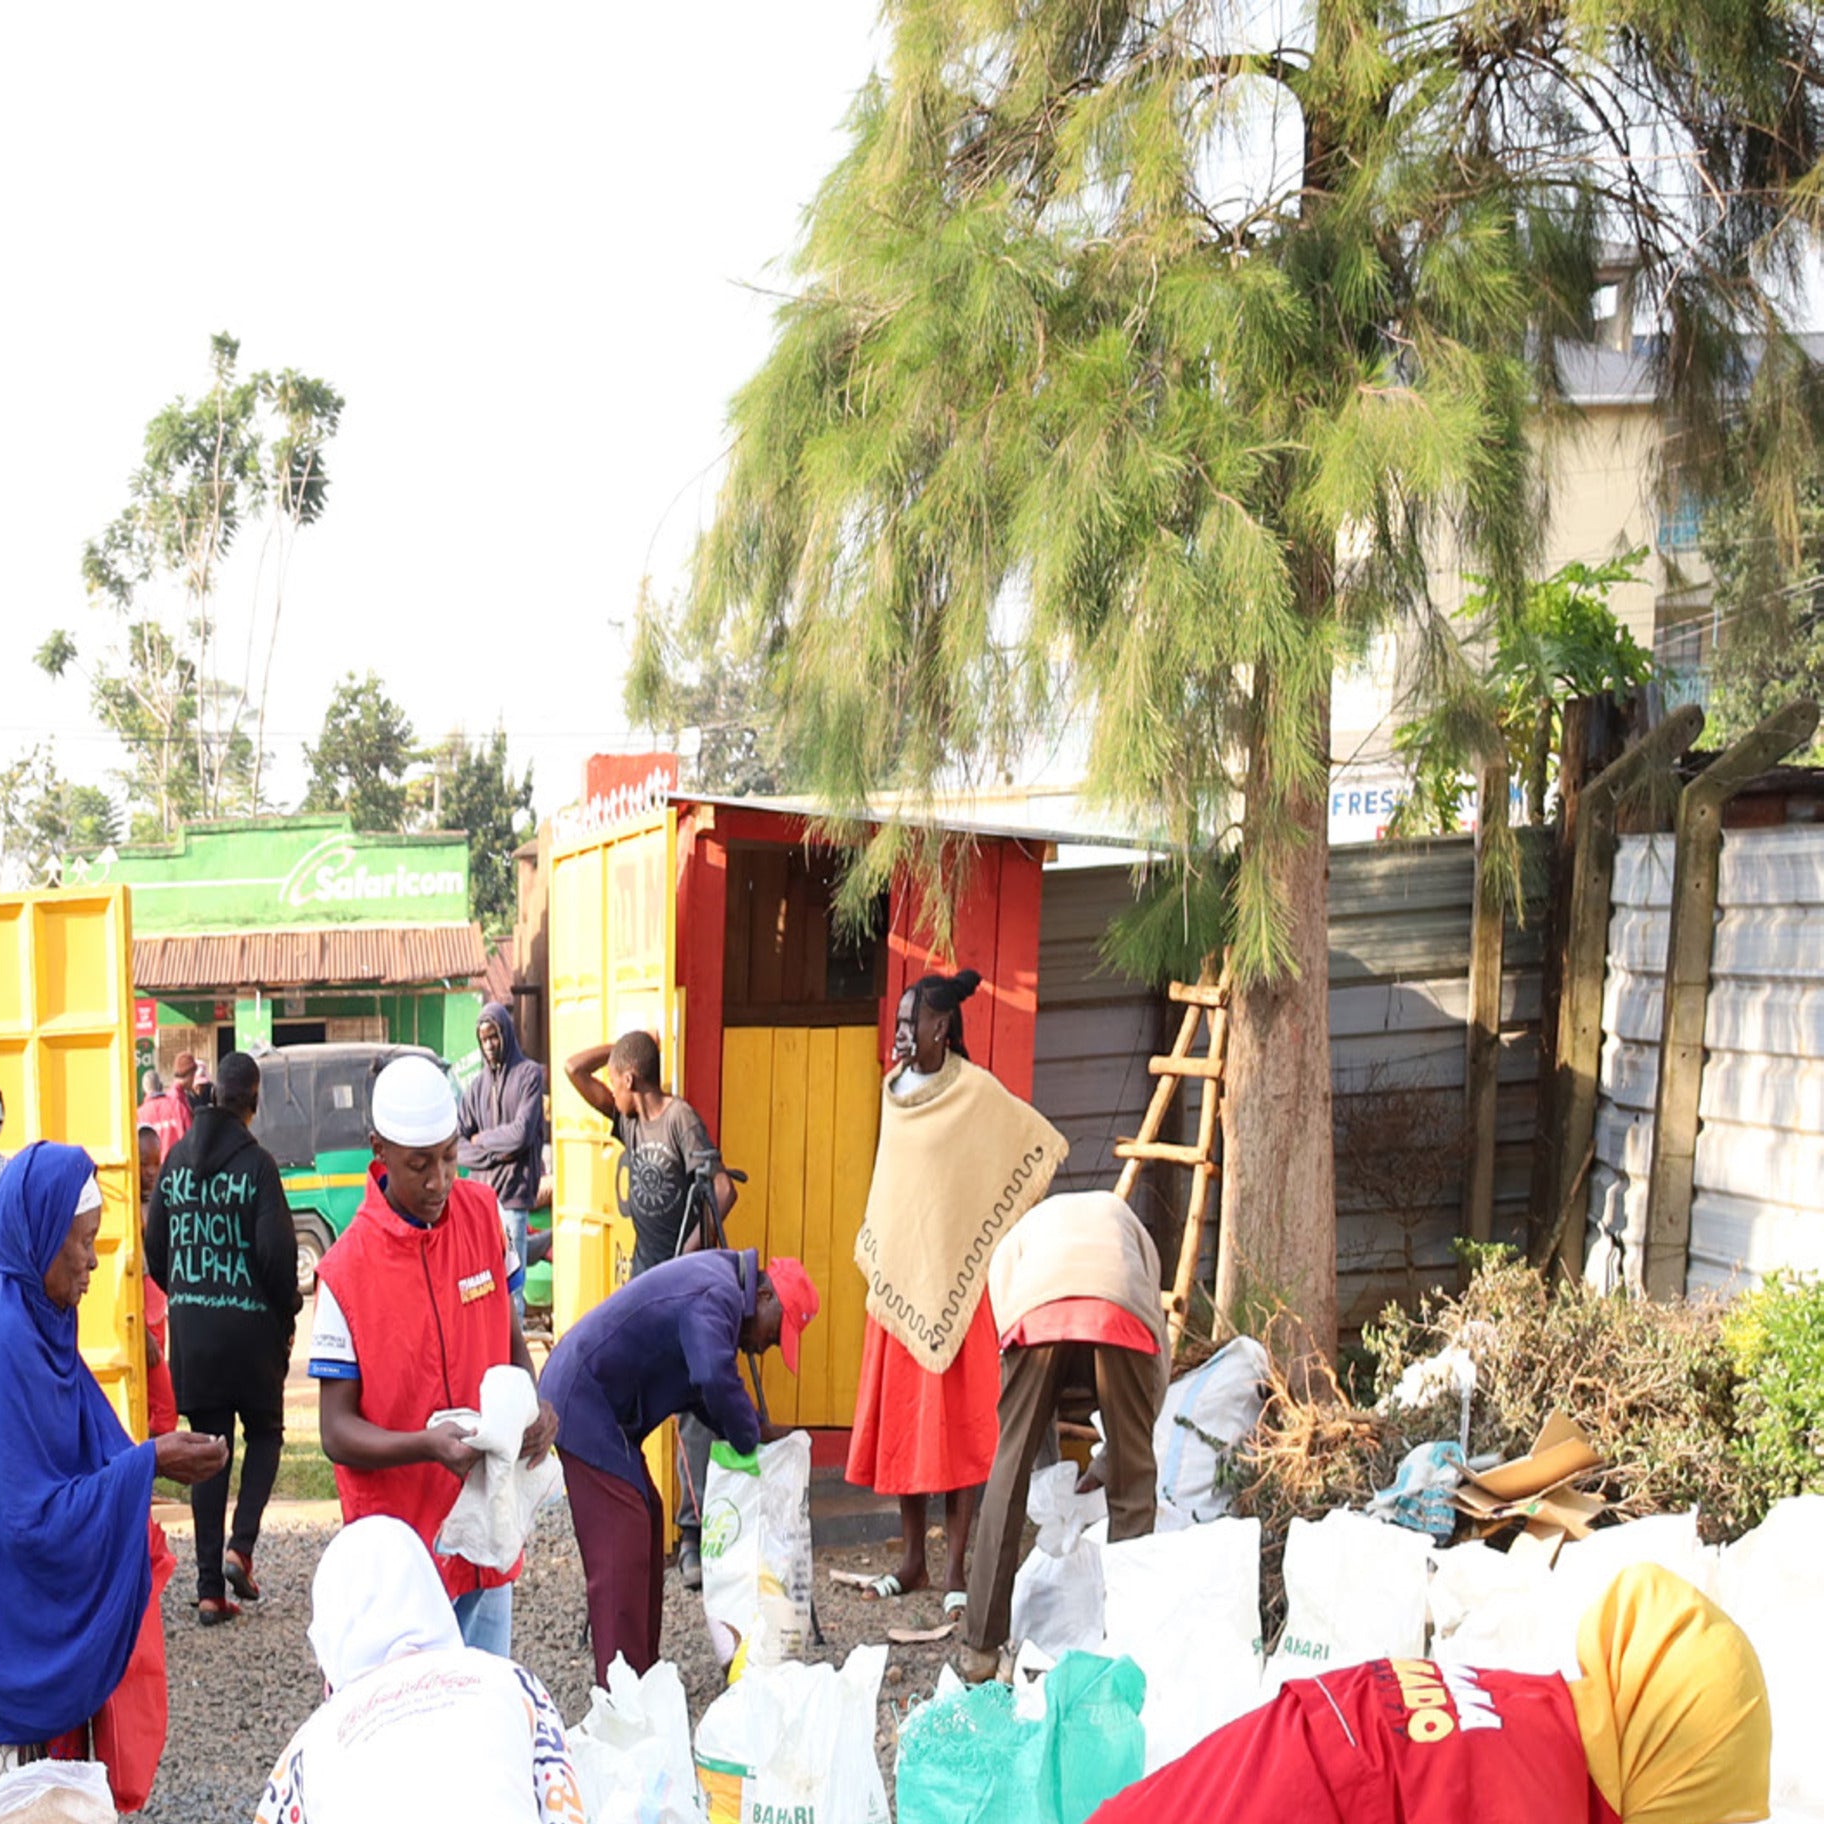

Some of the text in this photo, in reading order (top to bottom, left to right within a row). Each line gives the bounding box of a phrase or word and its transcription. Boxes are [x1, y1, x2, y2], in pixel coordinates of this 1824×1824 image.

[314, 865, 465, 902] Safaricom
[169, 1211, 251, 1249] PENCIL
[170, 1246, 252, 1287] ALPHA
